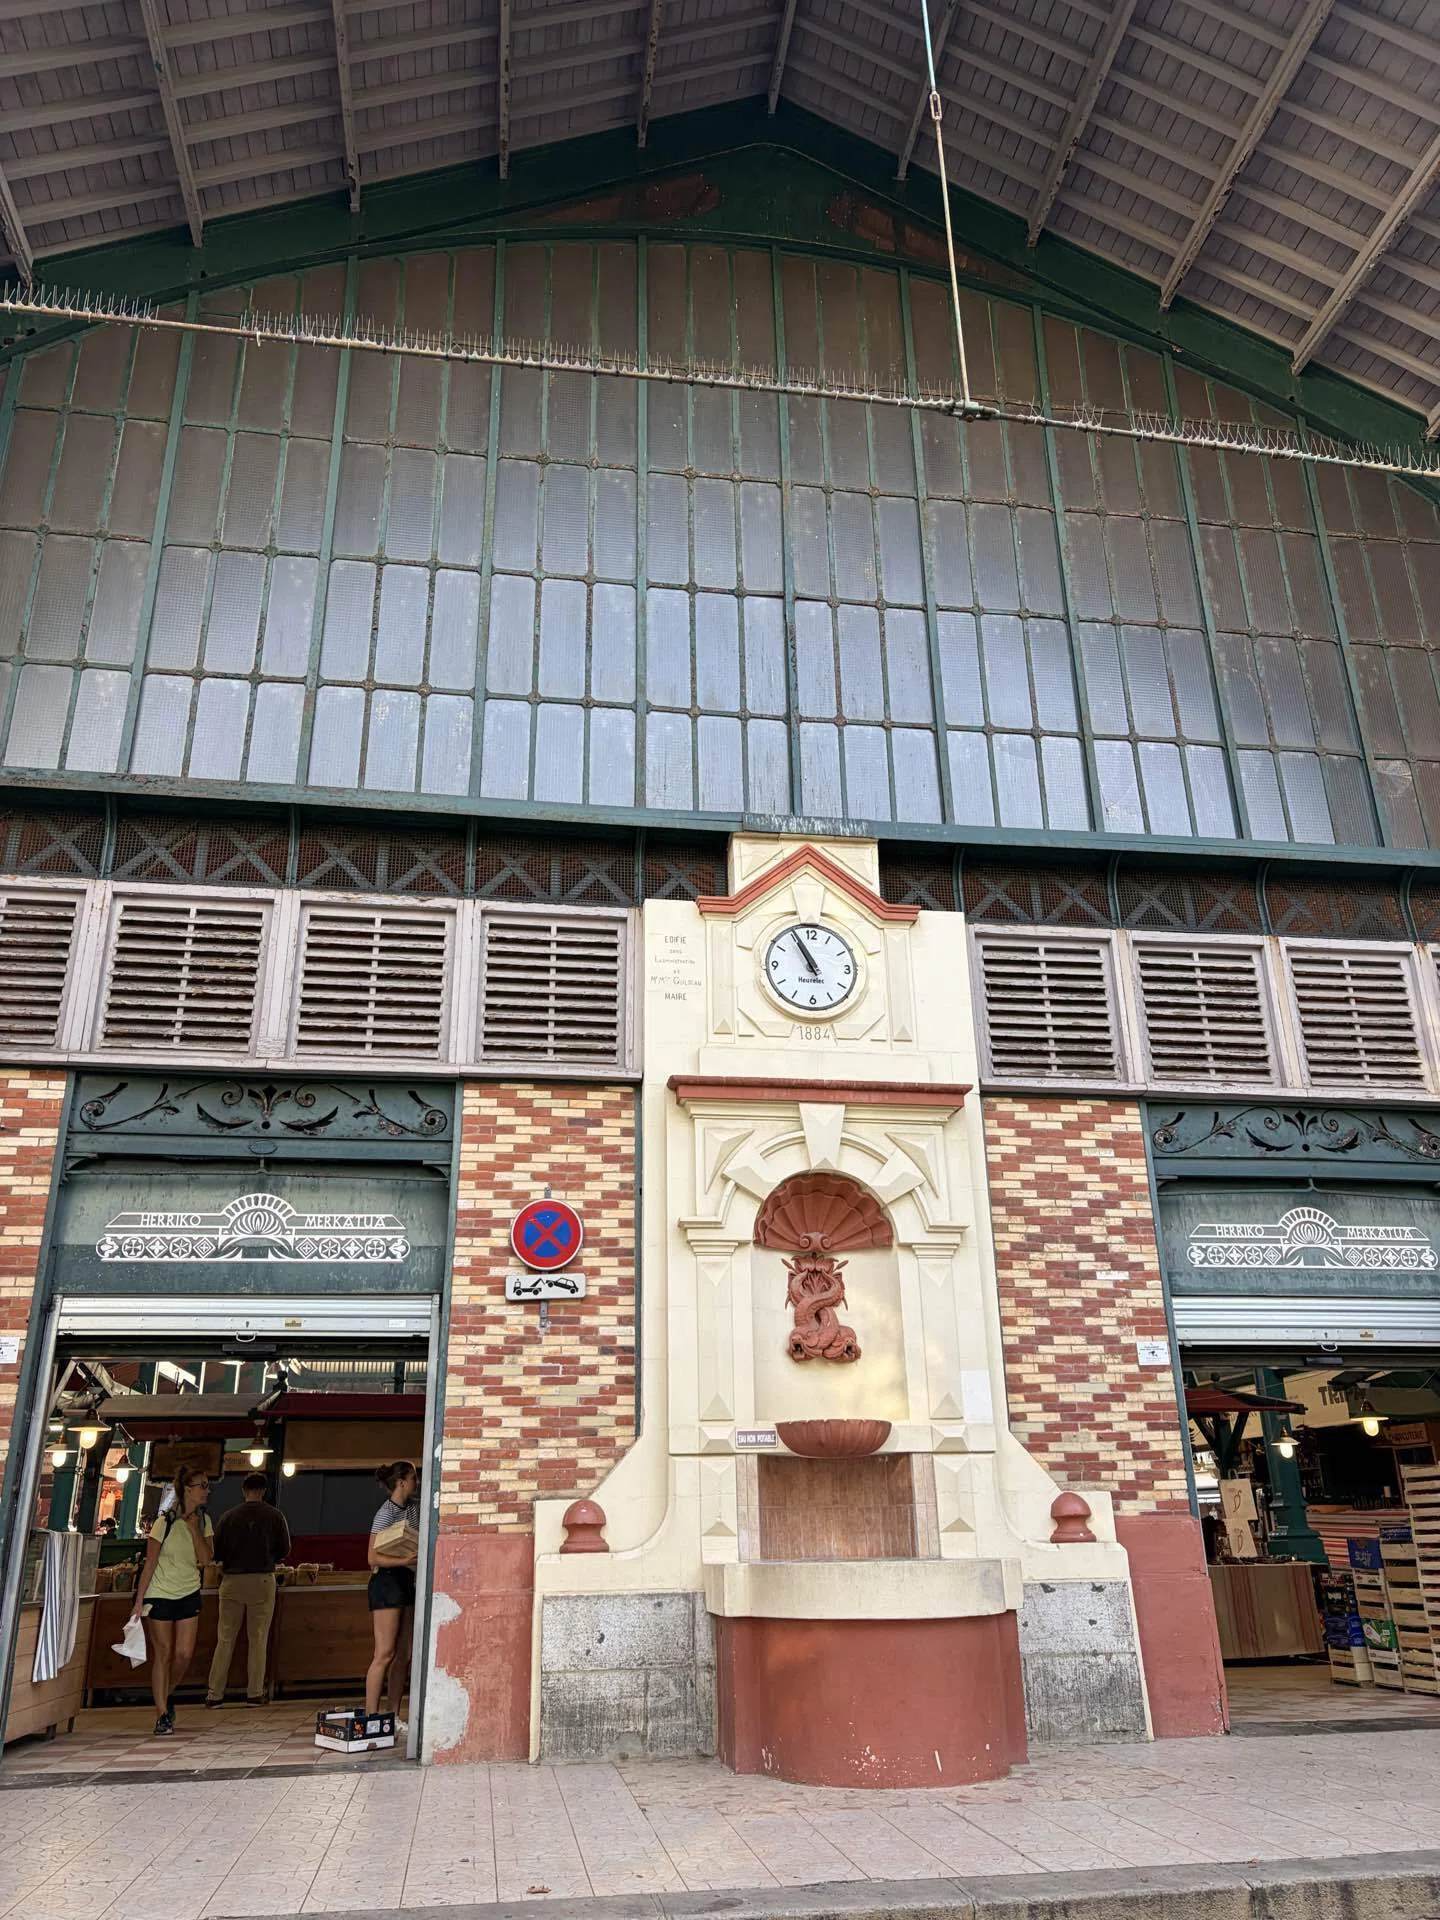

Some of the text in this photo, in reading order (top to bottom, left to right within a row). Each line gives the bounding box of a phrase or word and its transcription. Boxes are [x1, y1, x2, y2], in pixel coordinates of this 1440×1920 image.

[805, 929, 818, 941] 12
[771, 960, 851, 975] 9 3
[798, 976, 825, 985] Heurelec
[664, 992, 688, 1001] MAIRE
[808, 994, 817, 1005] 6
[796, 1025, 831, 1041] 1884
[140, 1214, 387, 1228] HERRIKO MERKATUA
[1215, 1225, 1413, 1239] HERRIKO MERKATUA
